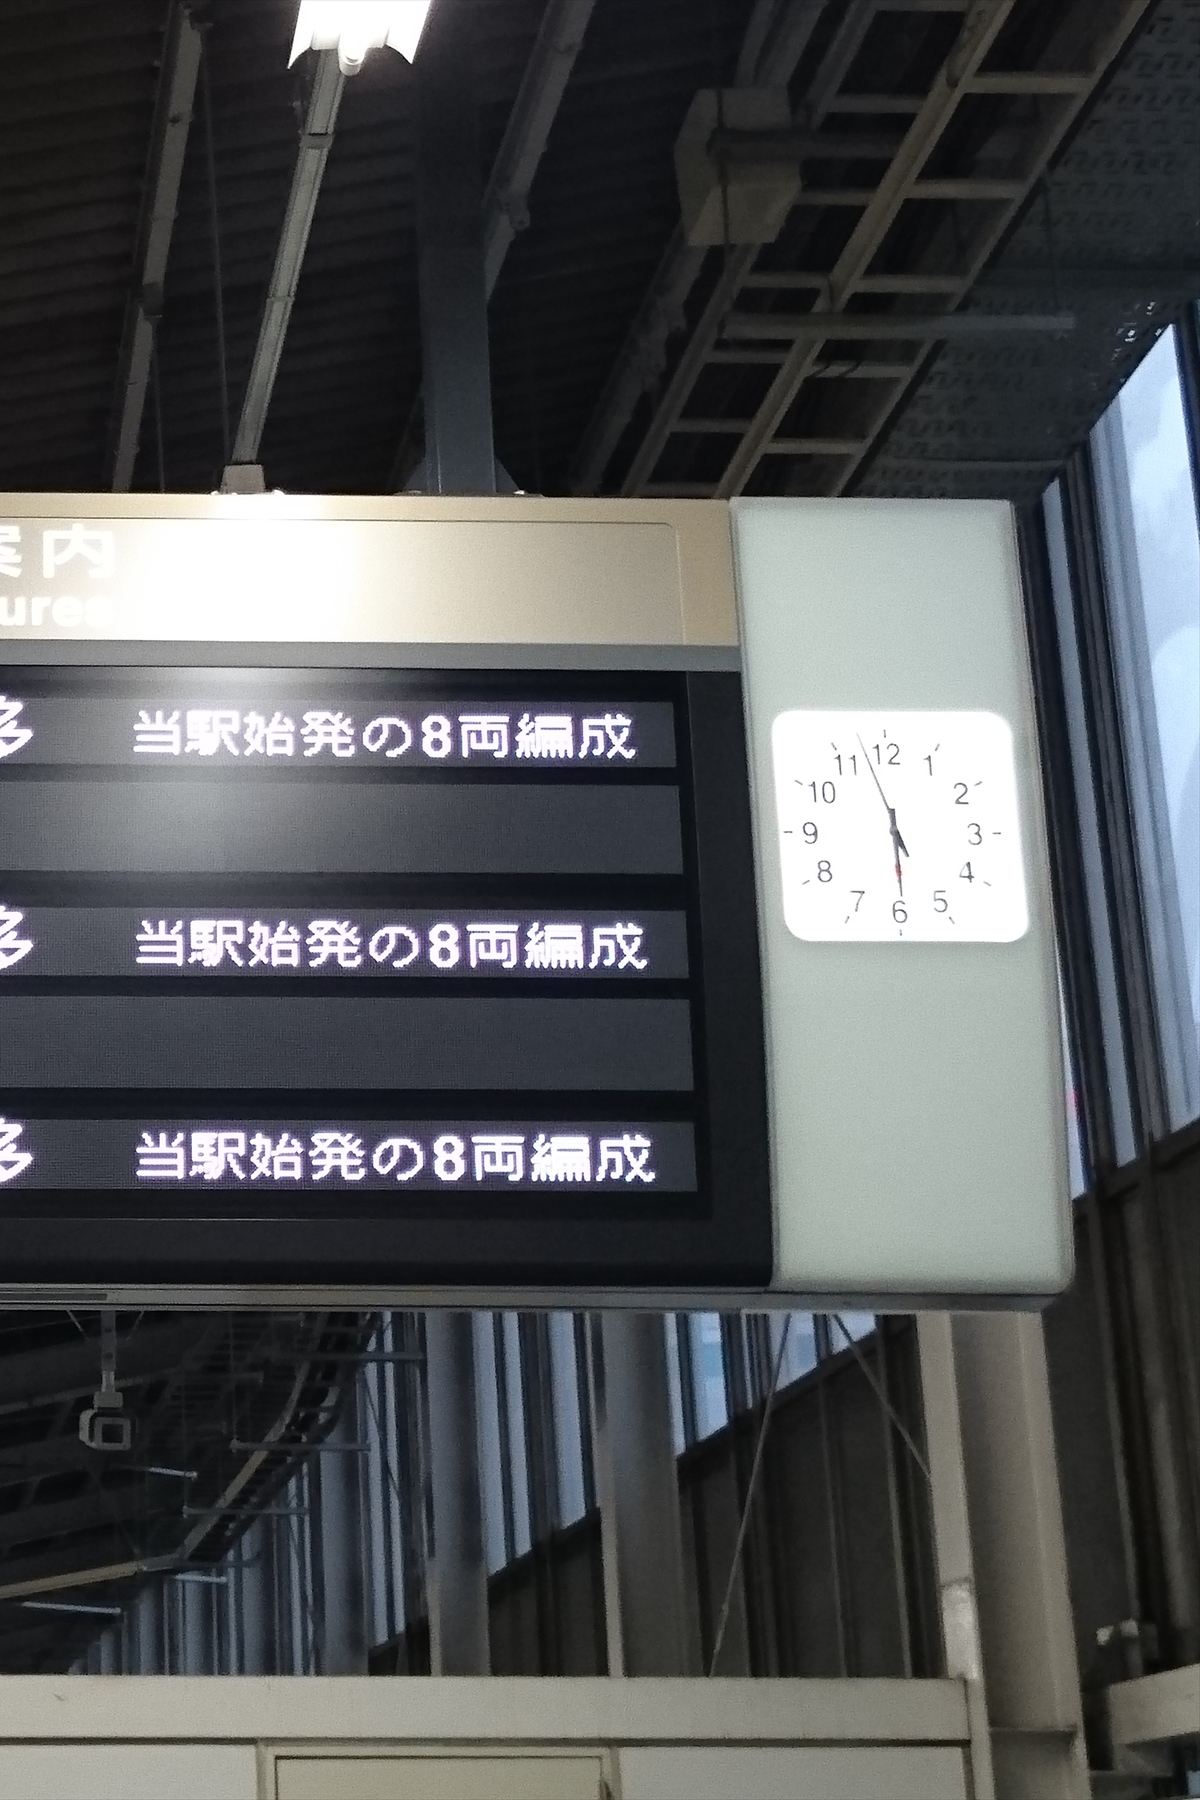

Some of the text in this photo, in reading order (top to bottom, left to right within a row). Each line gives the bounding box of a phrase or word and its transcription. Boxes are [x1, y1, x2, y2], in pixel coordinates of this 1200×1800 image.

[133, 709, 636, 760] 当駅始発の8両編成
[834, 754, 856, 775] 11
[872, 743, 900, 765] 12
[924, 755, 932, 776] 1
[808, 781, 836, 803] 10
[953, 783, 969, 805] 2
[802, 822, 818, 844] 9
[967, 823, 982, 845] 3
[817, 860, 832, 883] 8
[959, 861, 974, 883] 4
[850, 891, 865, 912] 7
[892, 900, 907, 923] 6
[933, 891, 948, 913] 5
[136, 919, 648, 969] 当駅始発の8両編成
[136, 1132, 656, 1182] 当駅始発の8両編成
